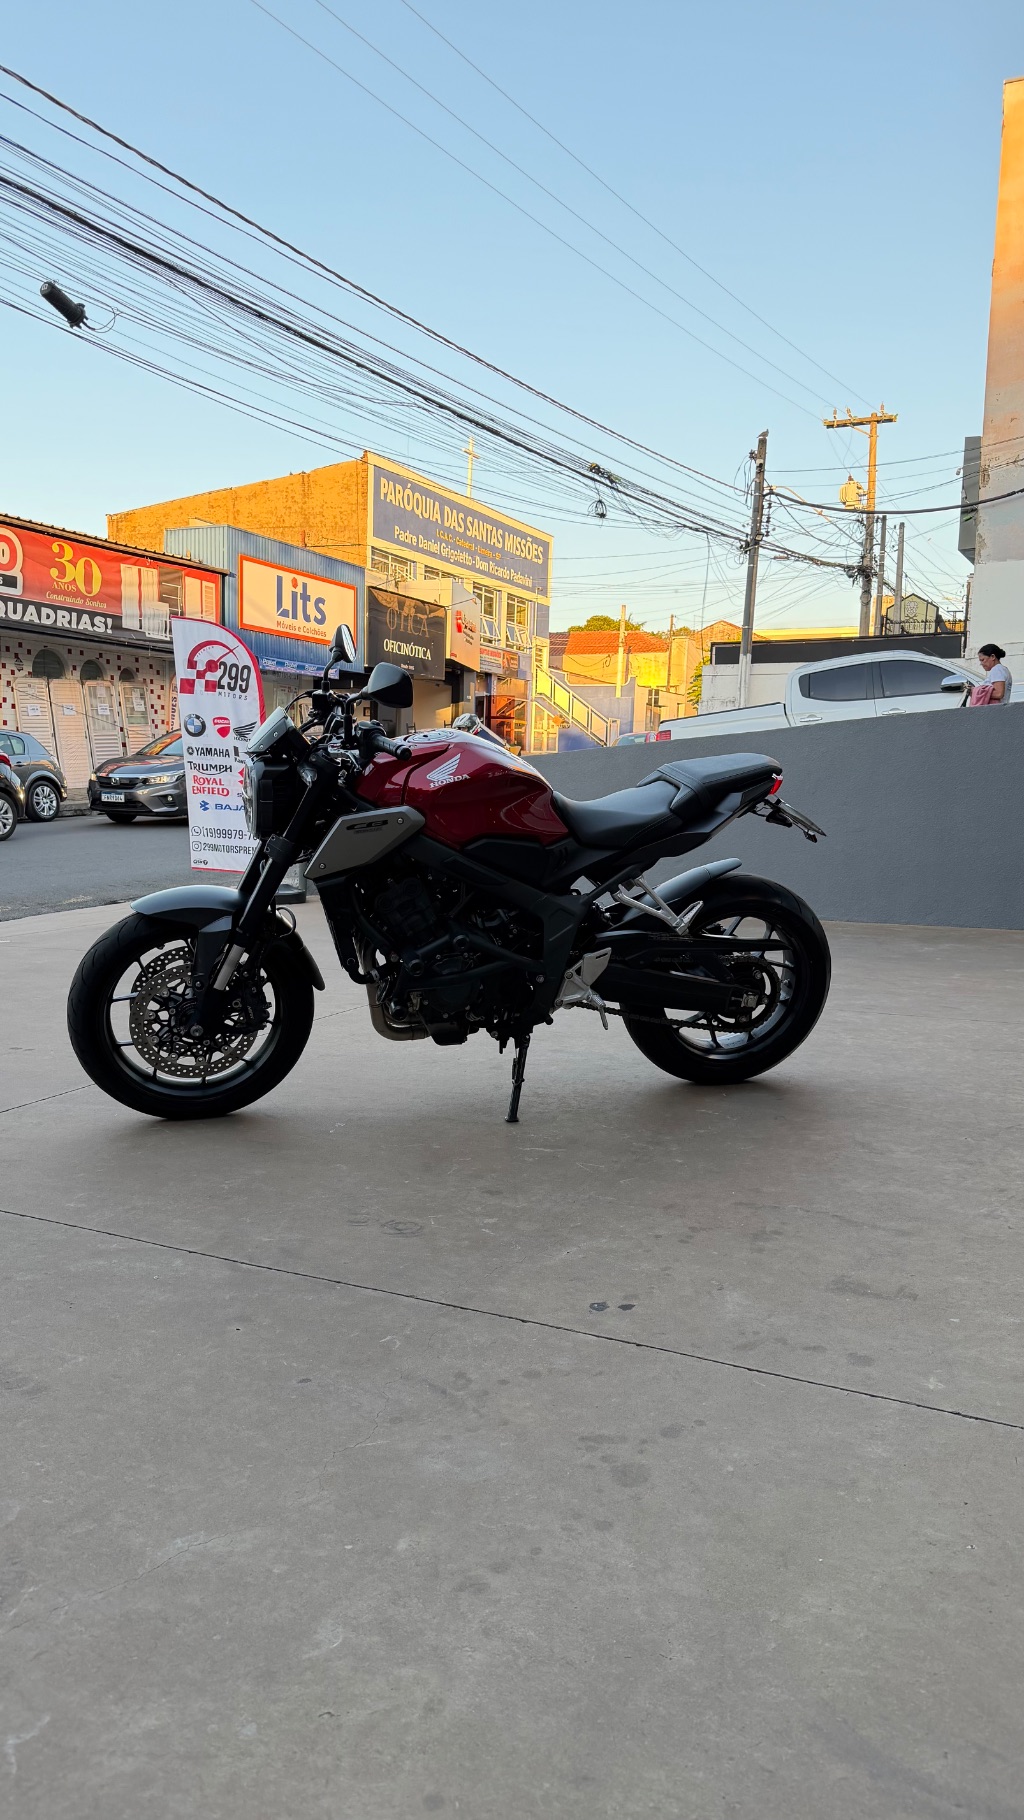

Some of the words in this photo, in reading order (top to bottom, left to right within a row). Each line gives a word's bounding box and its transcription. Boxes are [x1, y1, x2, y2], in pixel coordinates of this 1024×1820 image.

[380, 477, 442, 525] PARÓQUIA
[444, 505, 465, 533] DAS
[466, 516, 503, 549] SANTAS
[504, 532, 544, 565] MISSÕES
[394, 525, 417, 546] Padre
[418, 534, 440, 555] Daniel
[475, 556, 489, 572] Dom
[489, 561, 510, 580] Ricardo
[50, 541, 102, 597] 30
[52, 581, 77, 593] ANOS
[46, 591, 84, 605] Construindo
[276, 575, 327, 626] Lits
[276, 620, 297, 633] Móveis
[302, 626, 327, 638] Colchões
[383, 638, 432, 660] OFICINÓTICA
[217, 660, 252, 694] 299
[195, 746, 231, 758] YAMAHA
[187, 761, 233, 773] TRIUMPH
[192, 775, 224, 787] ROYAL
[430, 774, 471, 788] HONDA
[191, 786, 230, 797] ENFIELD
